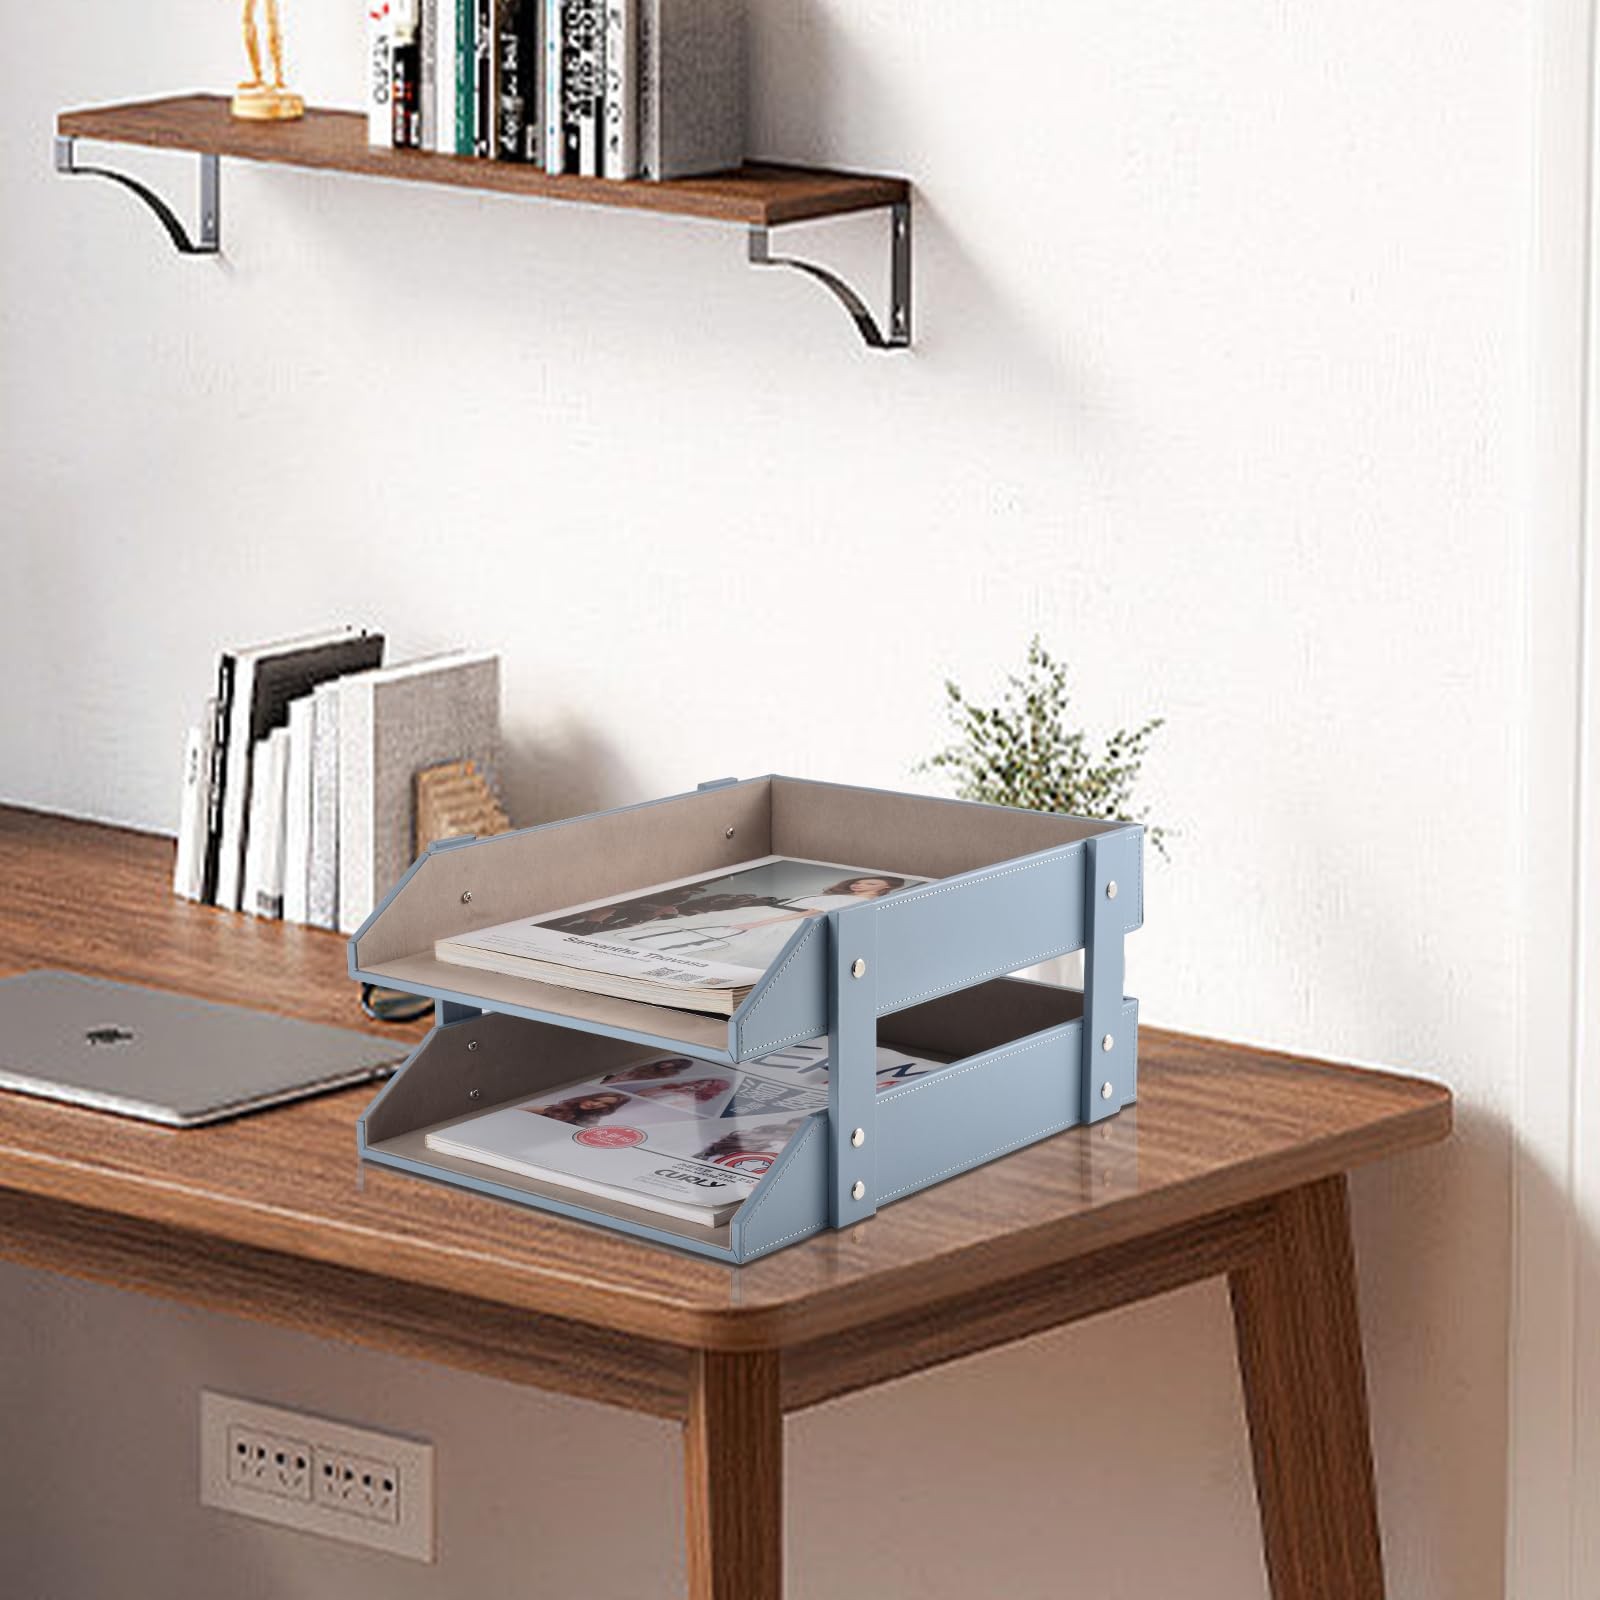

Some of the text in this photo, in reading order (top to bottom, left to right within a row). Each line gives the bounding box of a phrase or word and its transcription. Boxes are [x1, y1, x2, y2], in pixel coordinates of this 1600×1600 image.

[563, 936, 640, 955] Samantha
[644, 953, 710, 968] Thavasa
[654, 1169, 727, 1188] CURLY
